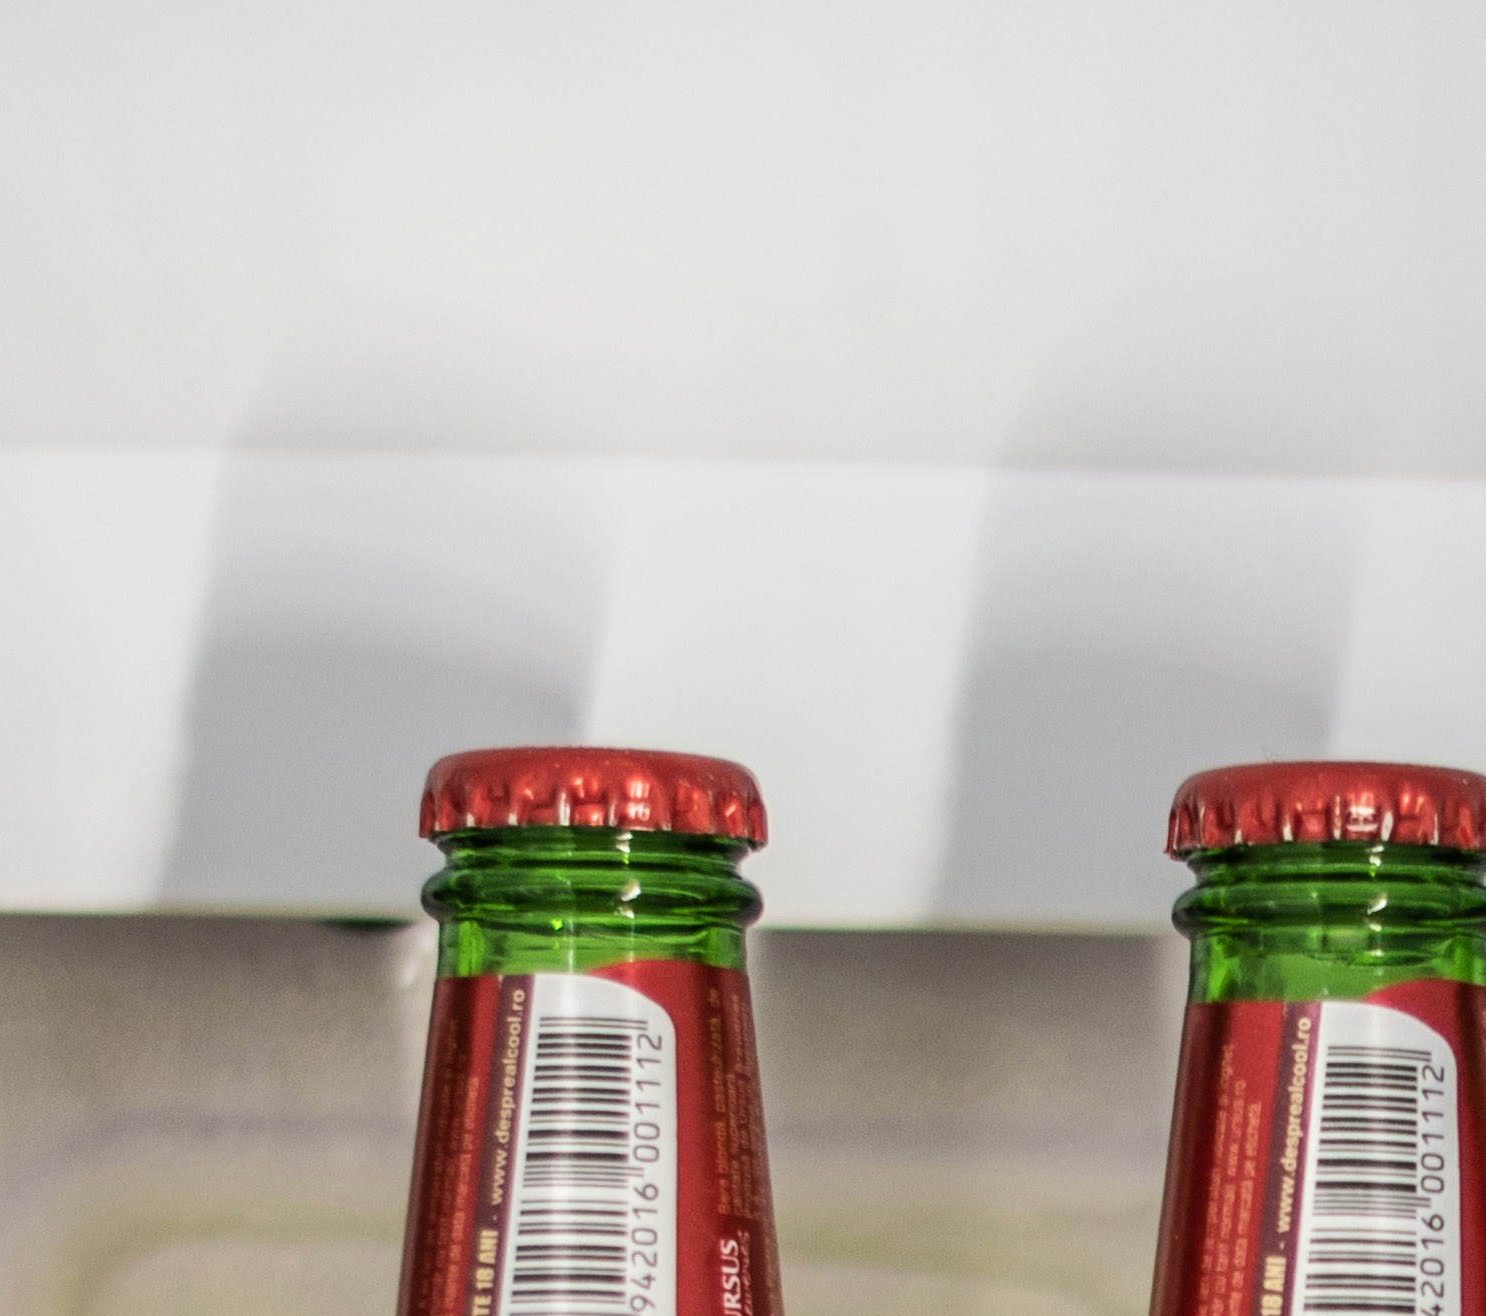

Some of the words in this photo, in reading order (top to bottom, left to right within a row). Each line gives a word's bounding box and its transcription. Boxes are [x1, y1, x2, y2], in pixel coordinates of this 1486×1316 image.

[490, 989, 526, 1205] www.desprealcool.ro
[1263, 1256, 1287, 1291] ANI
[1276, 1017, 1311, 1233] www.desprealcool.ro
[476, 1268, 495, 1290] 18
[478, 1229, 499, 1263] ANI
